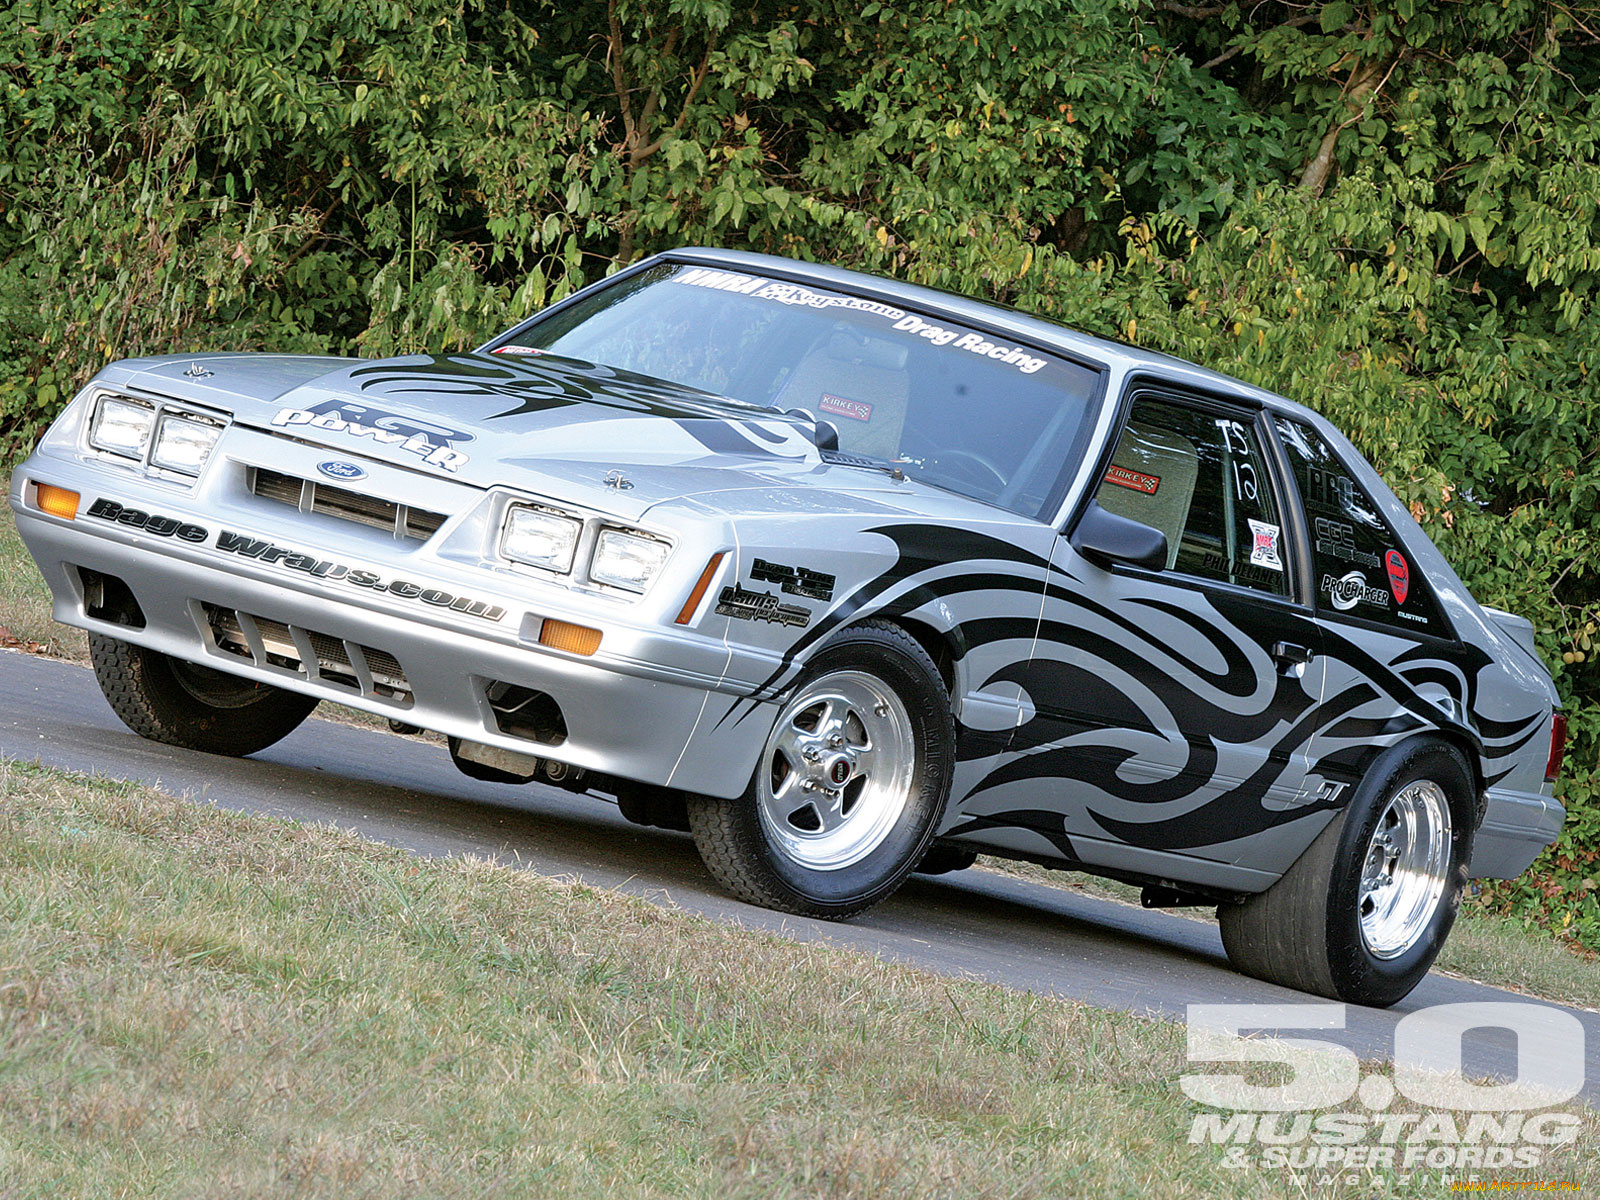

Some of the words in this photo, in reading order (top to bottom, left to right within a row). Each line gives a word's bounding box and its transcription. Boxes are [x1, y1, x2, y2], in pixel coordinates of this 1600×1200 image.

[672, 269, 768, 294] NMRA
[786, 286, 906, 319] Keystone
[892, 315, 959, 345] Drag
[953, 332, 1047, 374] Racing
[823, 396, 861, 411] KIRKEY
[271, 408, 470, 473] POWER
[1215, 419, 1249, 456] TS
[1107, 467, 1148, 484] KIRKEY
[1233, 460, 1261, 507] 12
[87, 497, 208, 543] Rage
[215, 528, 507, 622] Wraps.com
[1202, 553, 1230, 573] PHIL
[1231, 560, 1283, 584] DELANEY
[1398, 611, 1428, 624] MUSTANG
